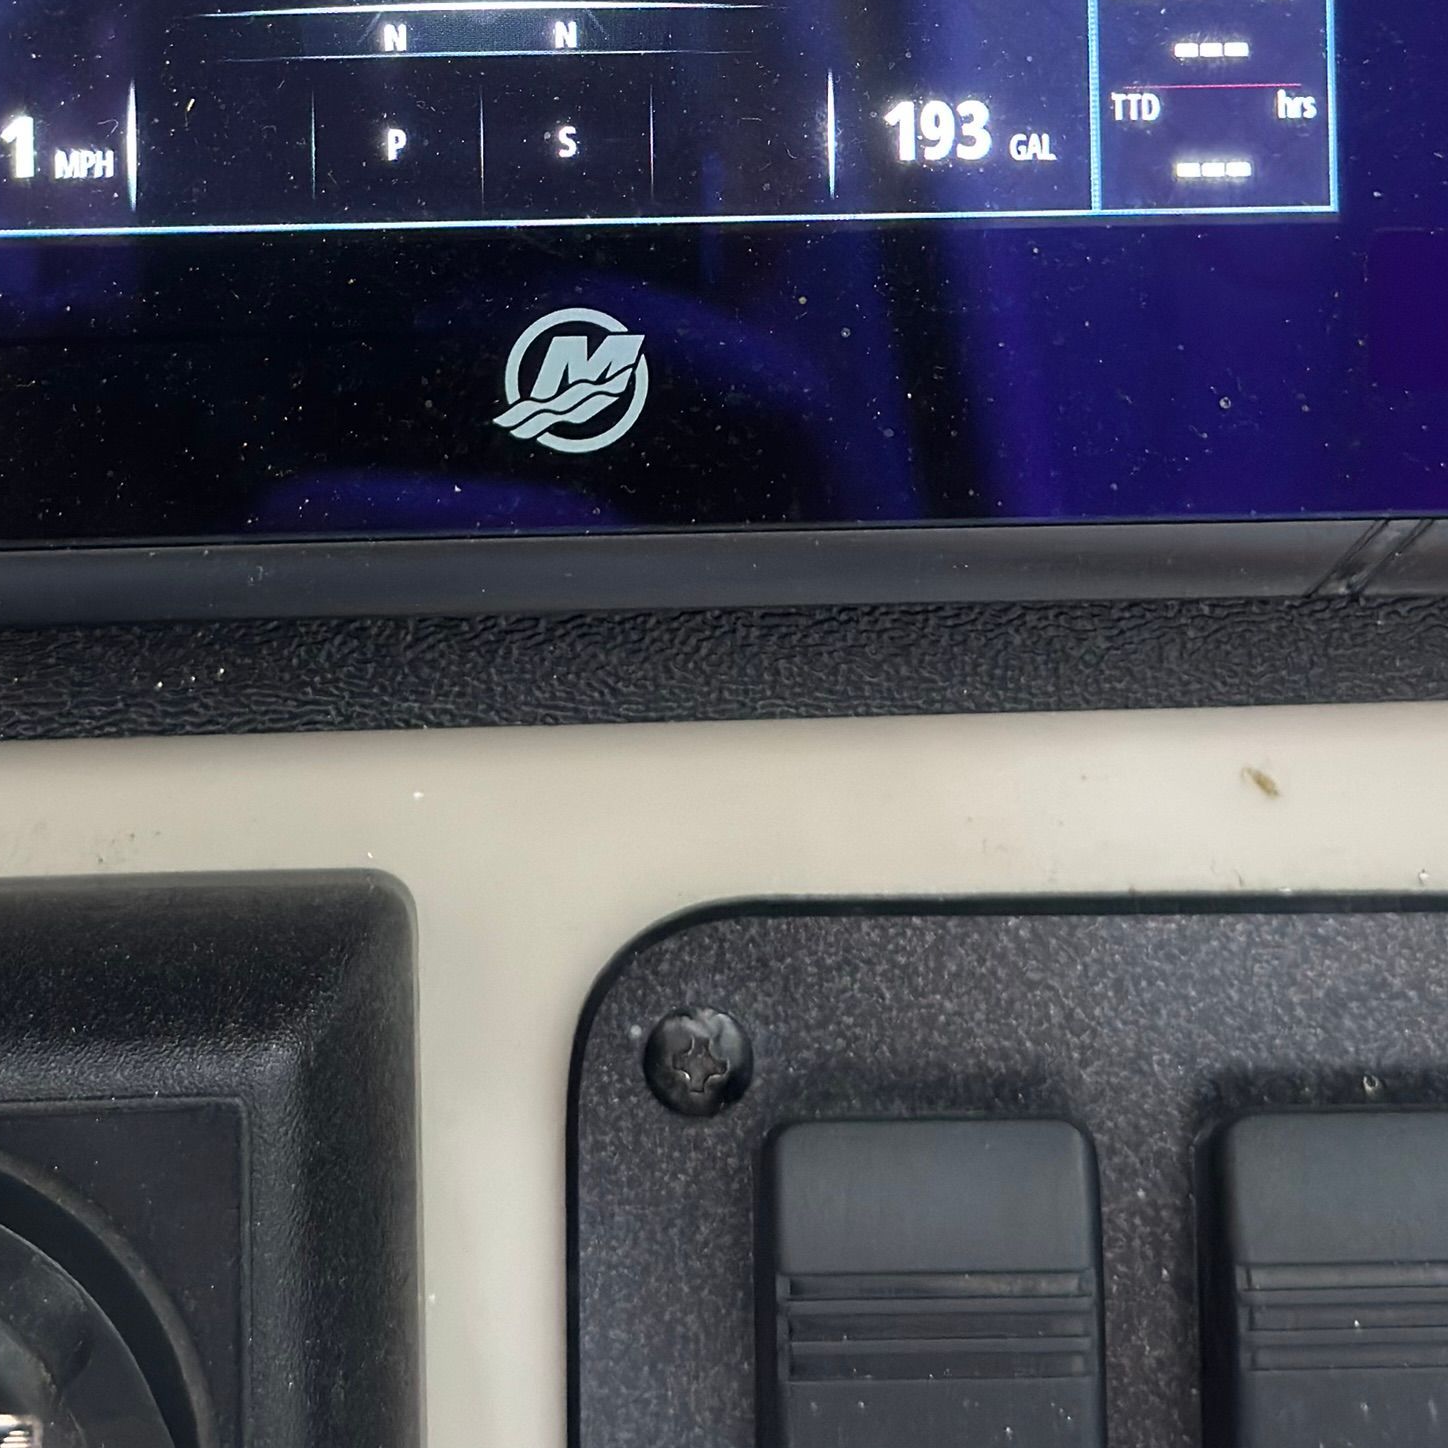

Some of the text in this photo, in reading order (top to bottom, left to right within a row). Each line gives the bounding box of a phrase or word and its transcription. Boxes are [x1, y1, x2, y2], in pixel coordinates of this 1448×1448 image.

[381, 23, 406, 51] N
[553, 21, 577, 48] N
[1111, 88, 1318, 121] TTD hrs
[387, 129, 406, 160] P
[558, 126, 577, 157] S
[883, 100, 1057, 161] 193 GAL
[0, 115, 113, 179] 1 MPH
